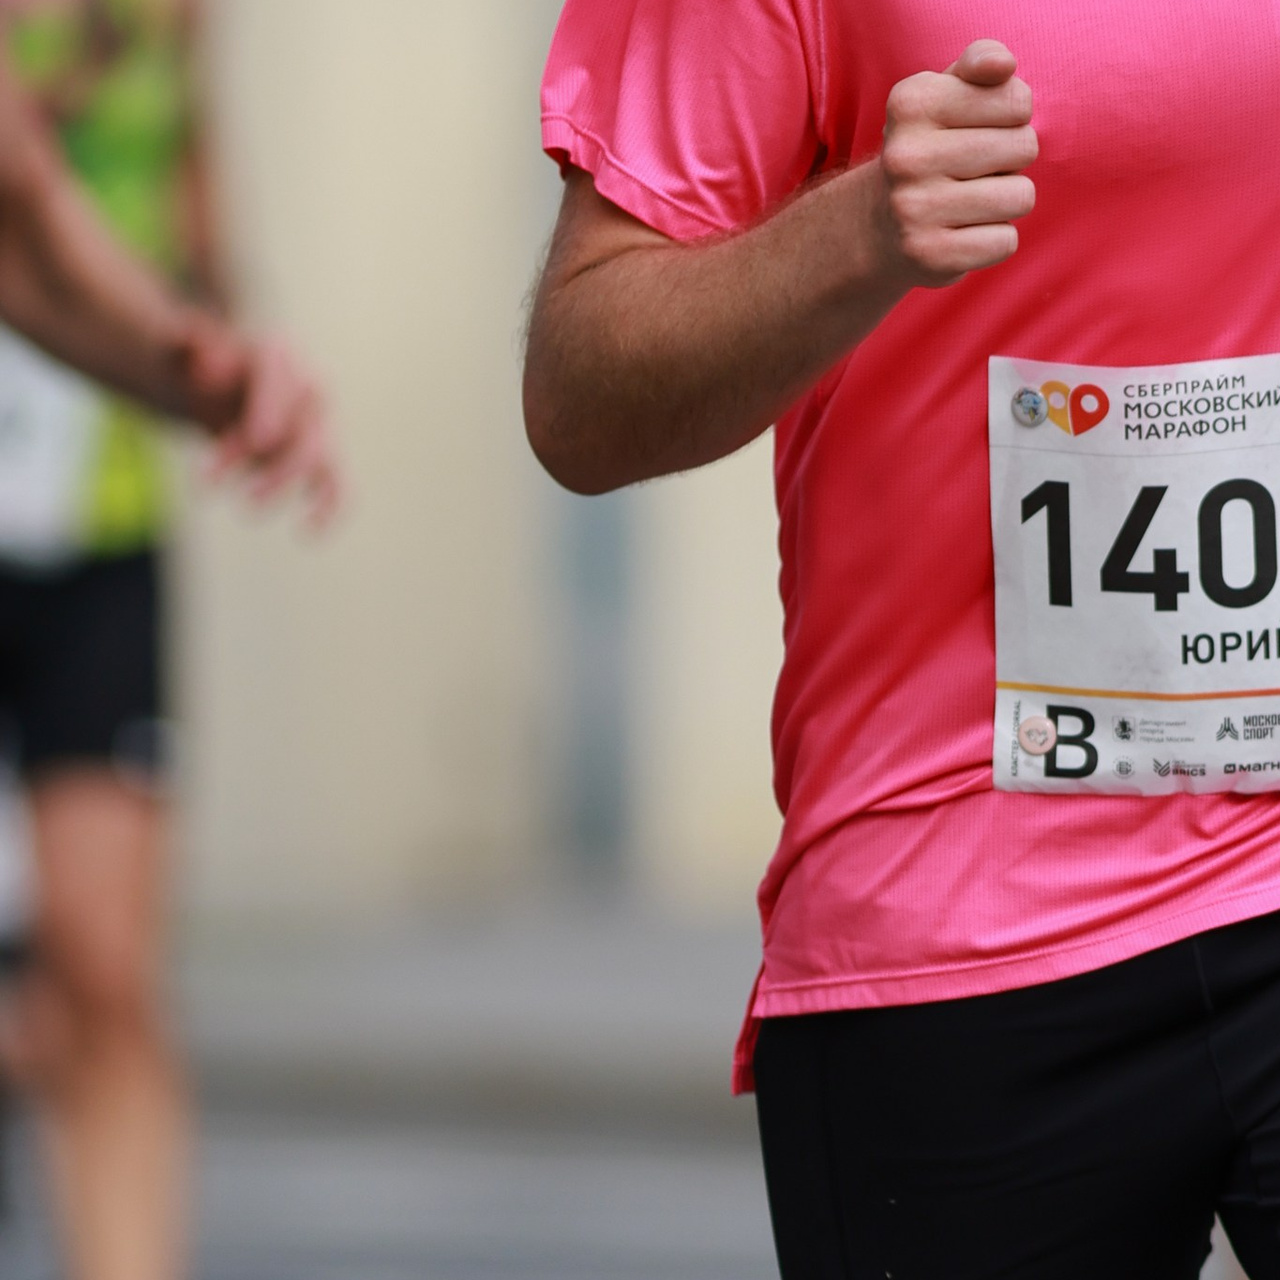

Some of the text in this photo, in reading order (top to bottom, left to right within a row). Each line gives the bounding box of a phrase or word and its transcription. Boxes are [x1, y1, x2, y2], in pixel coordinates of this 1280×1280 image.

[1123, 374, 1246, 398] СБЕРПРАЙМ
[1124, 414, 1247, 440] МАРАФОН
[1044, 704, 1099, 779] B
[1243, 727, 1274, 741] СПОРТ
